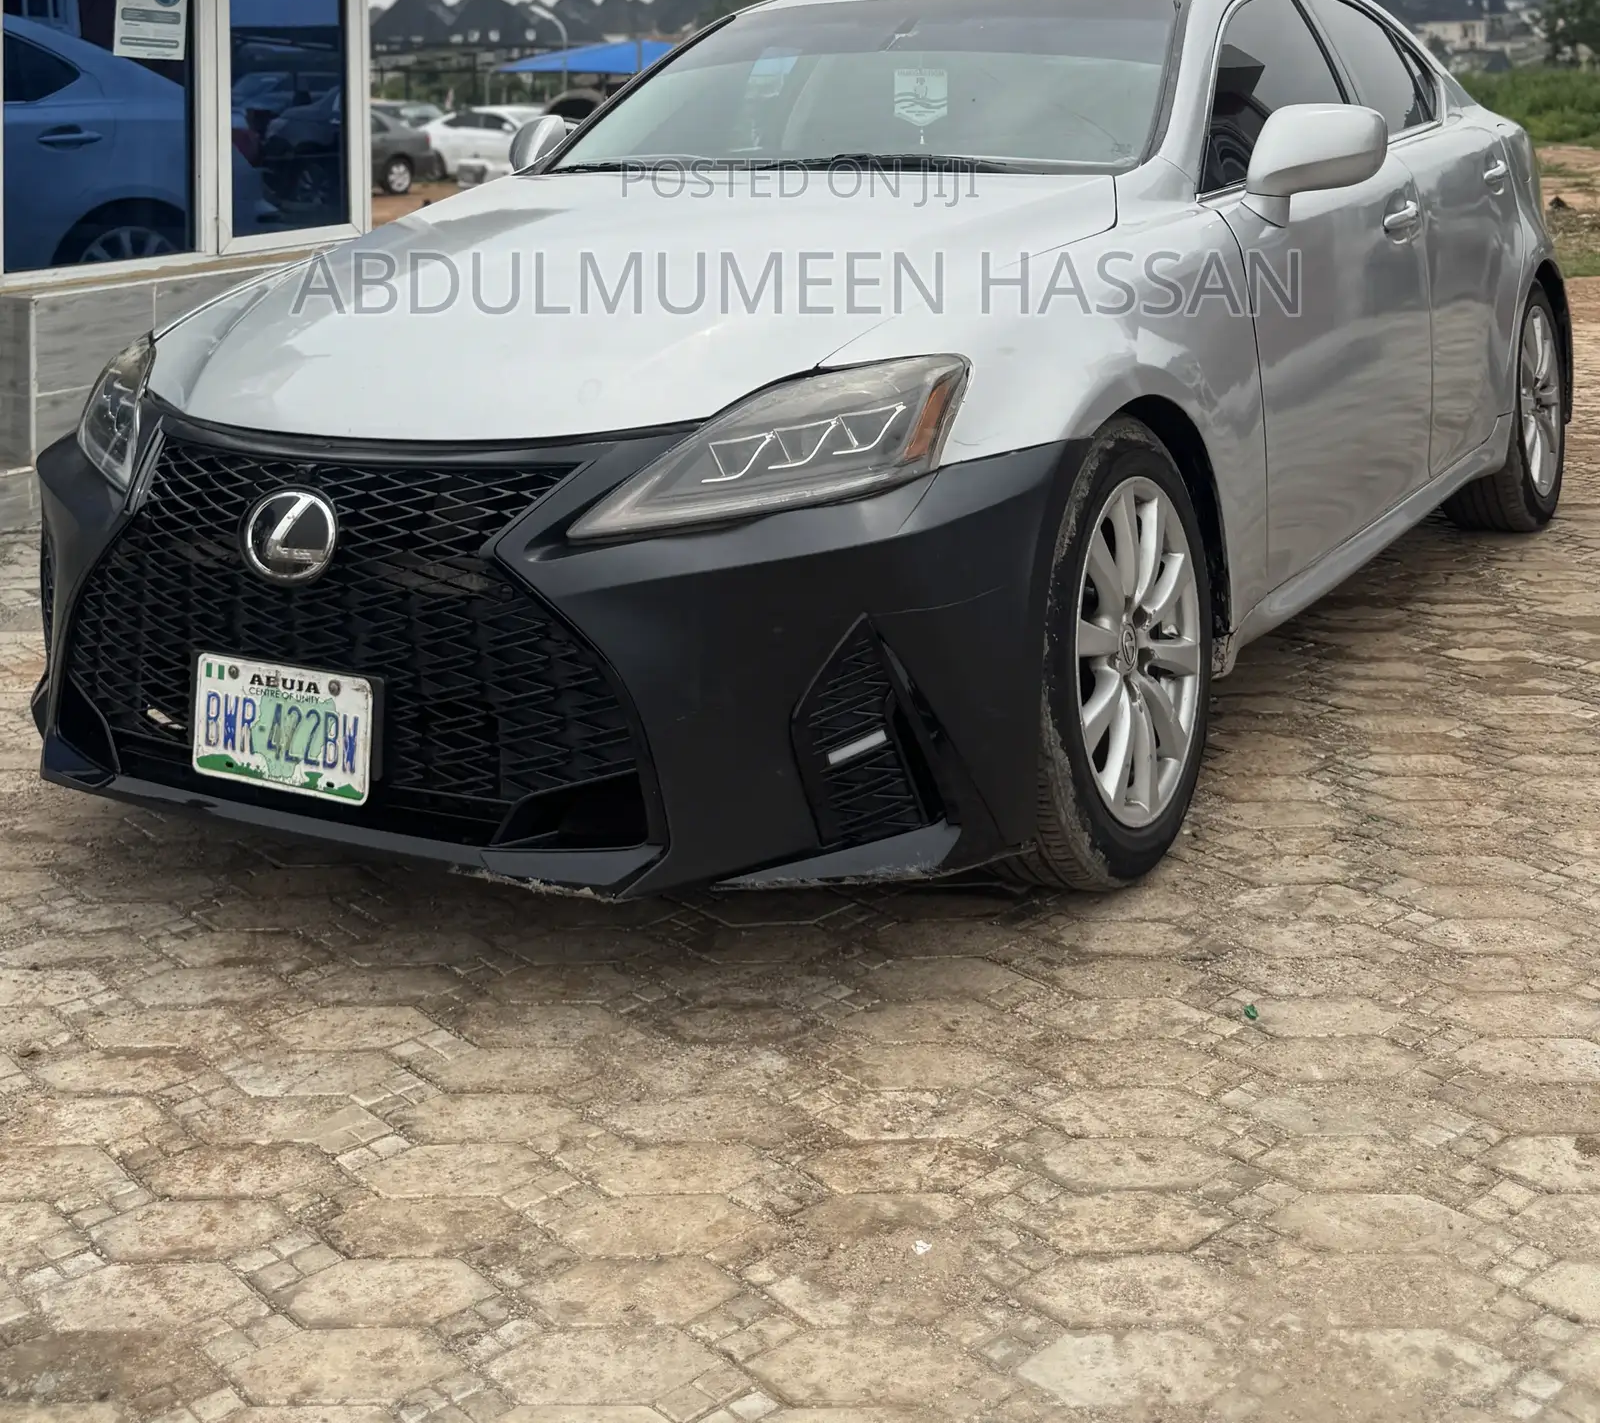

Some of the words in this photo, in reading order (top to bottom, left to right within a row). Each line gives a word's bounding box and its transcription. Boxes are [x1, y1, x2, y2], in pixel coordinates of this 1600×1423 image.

[249, 686, 280, 698] CENTRE
[281, 690, 293, 700] OF
[295, 693, 320, 704] UNITY
